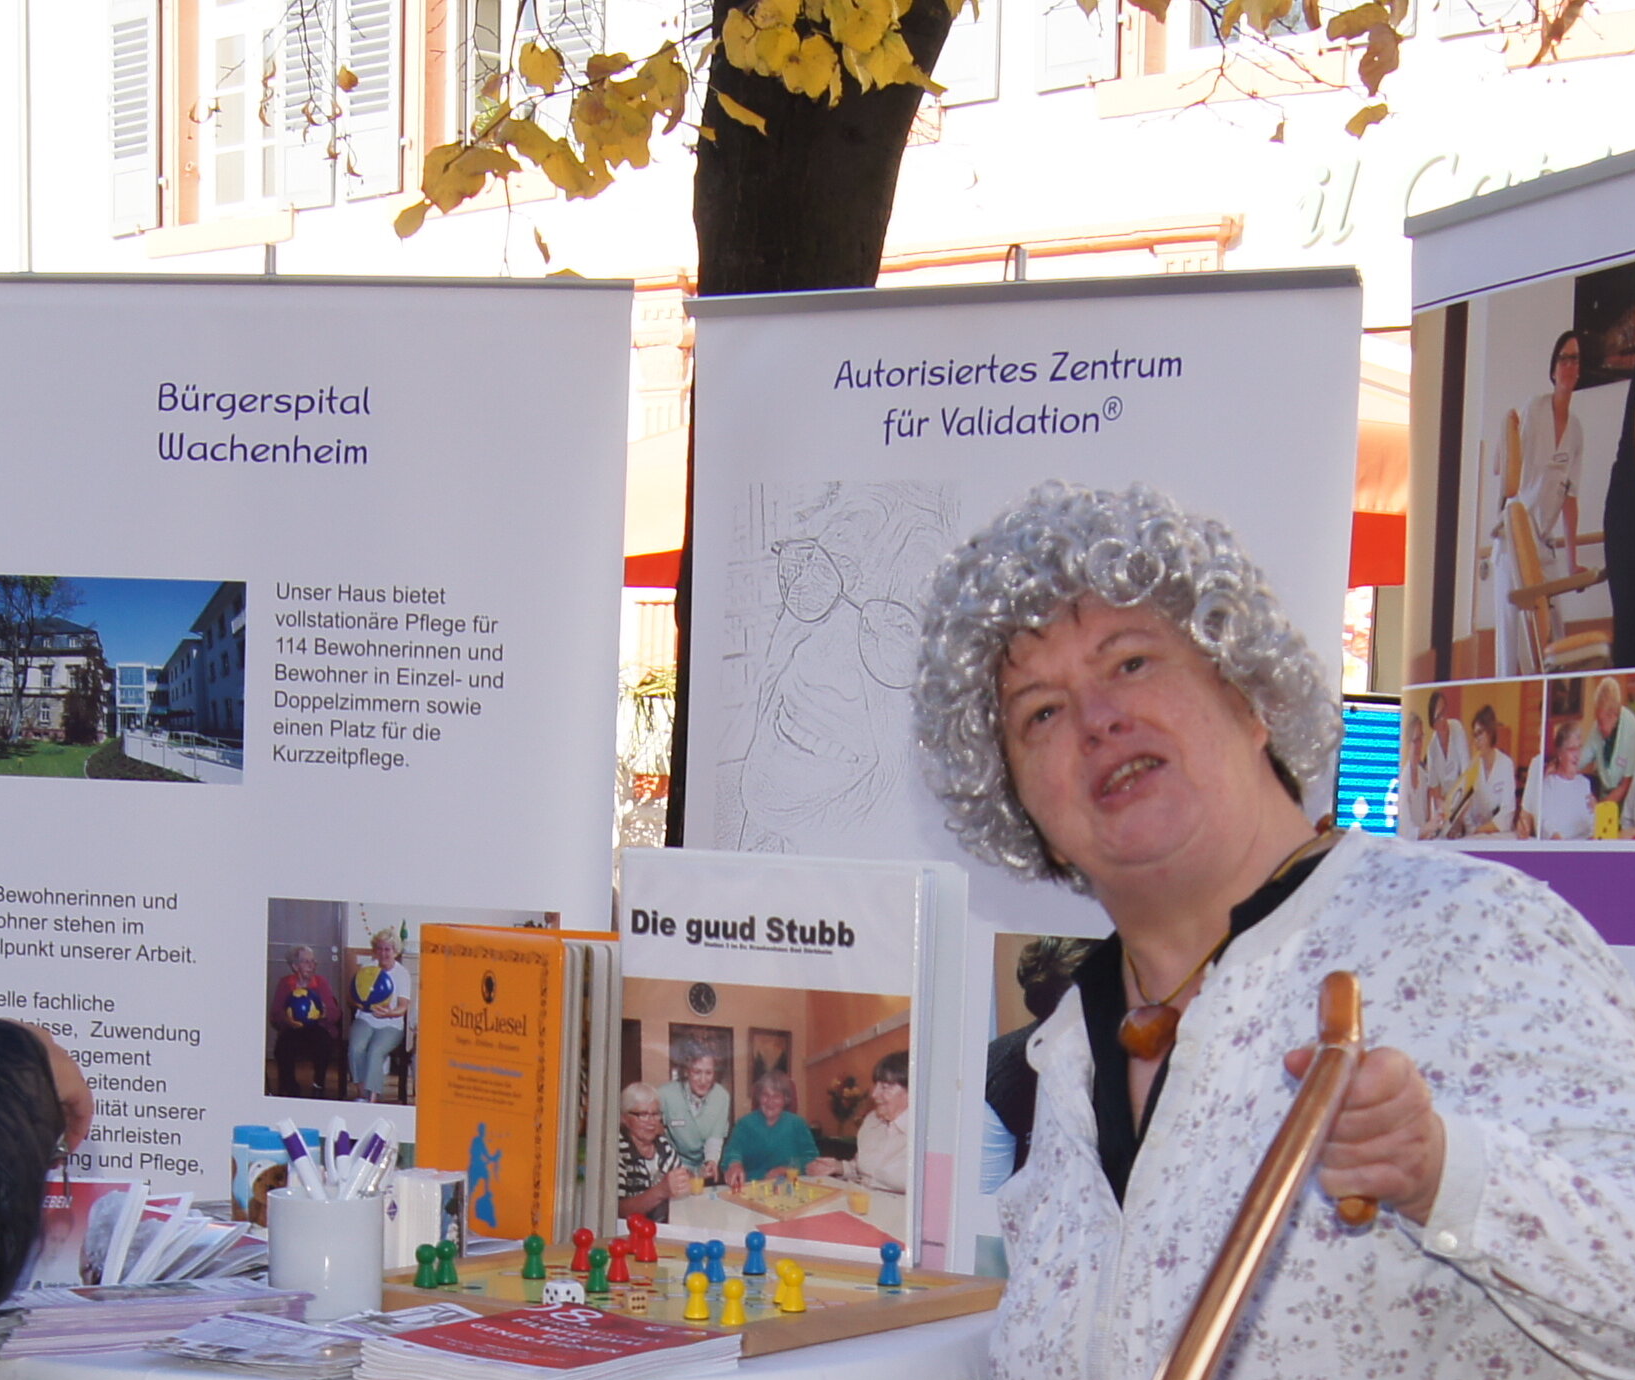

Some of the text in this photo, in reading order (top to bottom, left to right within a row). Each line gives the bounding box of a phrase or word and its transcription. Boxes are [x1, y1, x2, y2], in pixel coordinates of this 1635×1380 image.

[834, 350, 1181, 389] Autorisiertes Zentrum
[158, 381, 370, 420] Bürgerspital
[883, 407, 928, 444] für
[158, 432, 368, 464] Wachenheim
[276, 583, 446, 605] Unser Haus bietet
[276, 610, 498, 635] vollstationäre Pflege für
[276, 637, 503, 661] 114 Bewohnerinnen und
[274, 665, 503, 688] Bewohner in Einzel- und
[274, 692, 481, 715] Doppelzimmern sowie
[273, 719, 440, 741] einen Platz für die
[273, 746, 409, 769] Kurzzeitpflege.
[143, 892, 178, 910] und
[54, 914, 116, 933] stehen
[122, 917, 144, 935] im
[631, 909, 855, 947] Die guud Stubb
[61, 942, 130, 962] unserer
[136, 945, 196, 964] Arbeit.
[33, 993, 114, 1012] fachliche
[90, 1021, 200, 1046] Zuwendung
[70, 1050, 151, 1068] agement
[86, 1076, 166, 1093] eitenden
[95, 1099, 206, 1120] lität unserer
[84, 1124, 181, 1145] ährleisten
[99, 1155, 132, 1169] und
[140, 1153, 204, 1175] Pflege,
